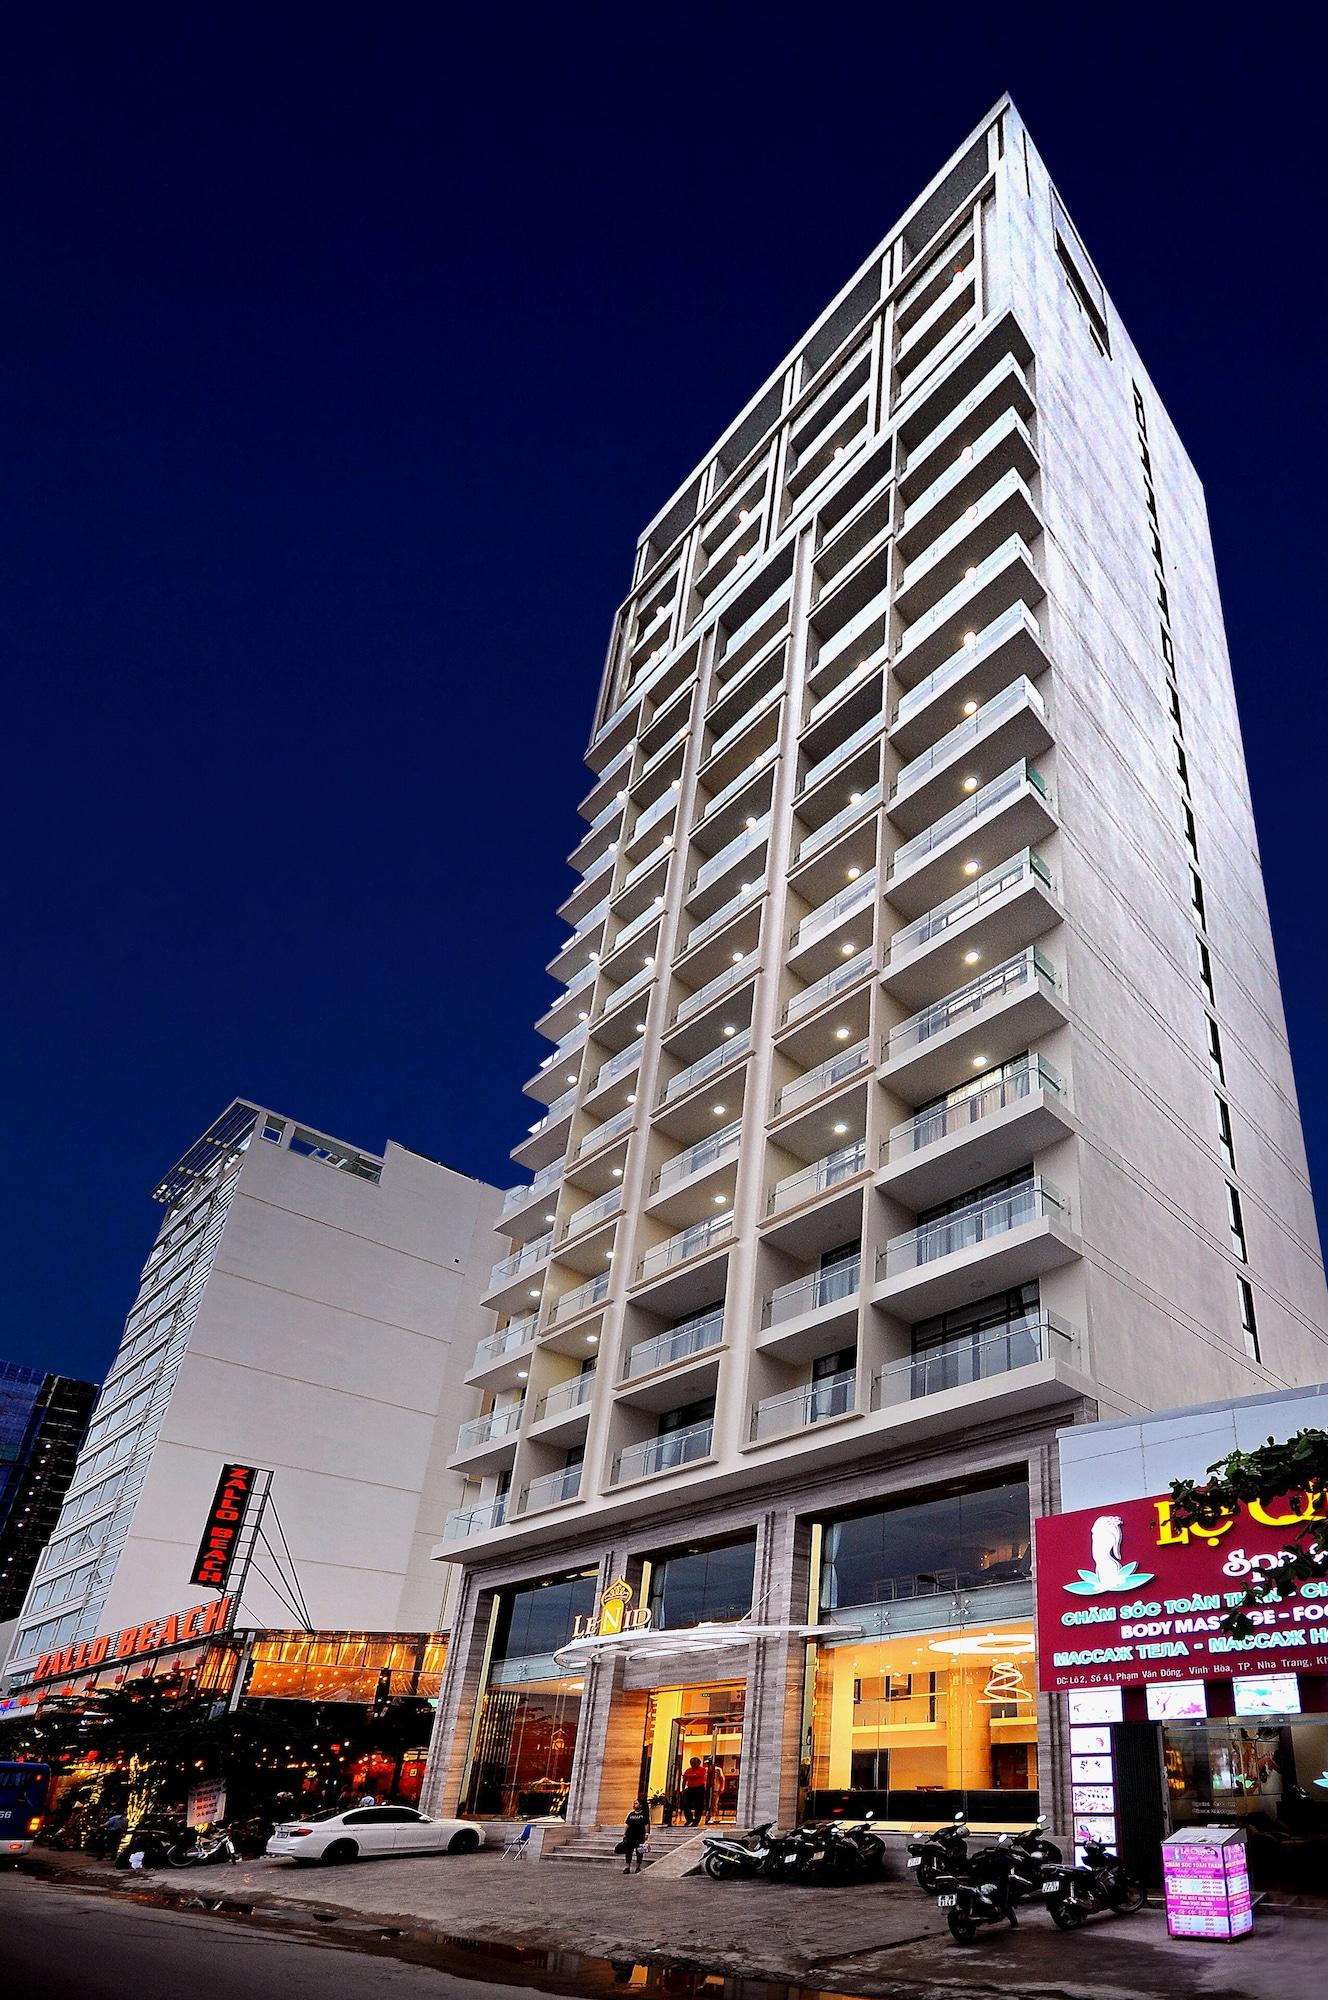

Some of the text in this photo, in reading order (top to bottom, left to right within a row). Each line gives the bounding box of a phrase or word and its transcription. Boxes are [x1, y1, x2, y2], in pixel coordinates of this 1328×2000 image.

[198, 1468, 249, 1582] ZALLO BEACH
[1119, 1600, 1162, 1620] SÓC
[1120, 1620, 1171, 1639] BODY
[1173, 1609, 1277, 1635] MASGE
[32, 1596, 231, 1682] ZALLO BEACH
[1053, 1645, 1134, 1667] МАССАЖ
[1135, 1641, 1190, 1660] ТЕЛА
[1237, 1662, 1254, 1671] TP.
[1257, 1660, 1277, 1670] Nha
[1280, 1658, 1313, 1669] Trang,
